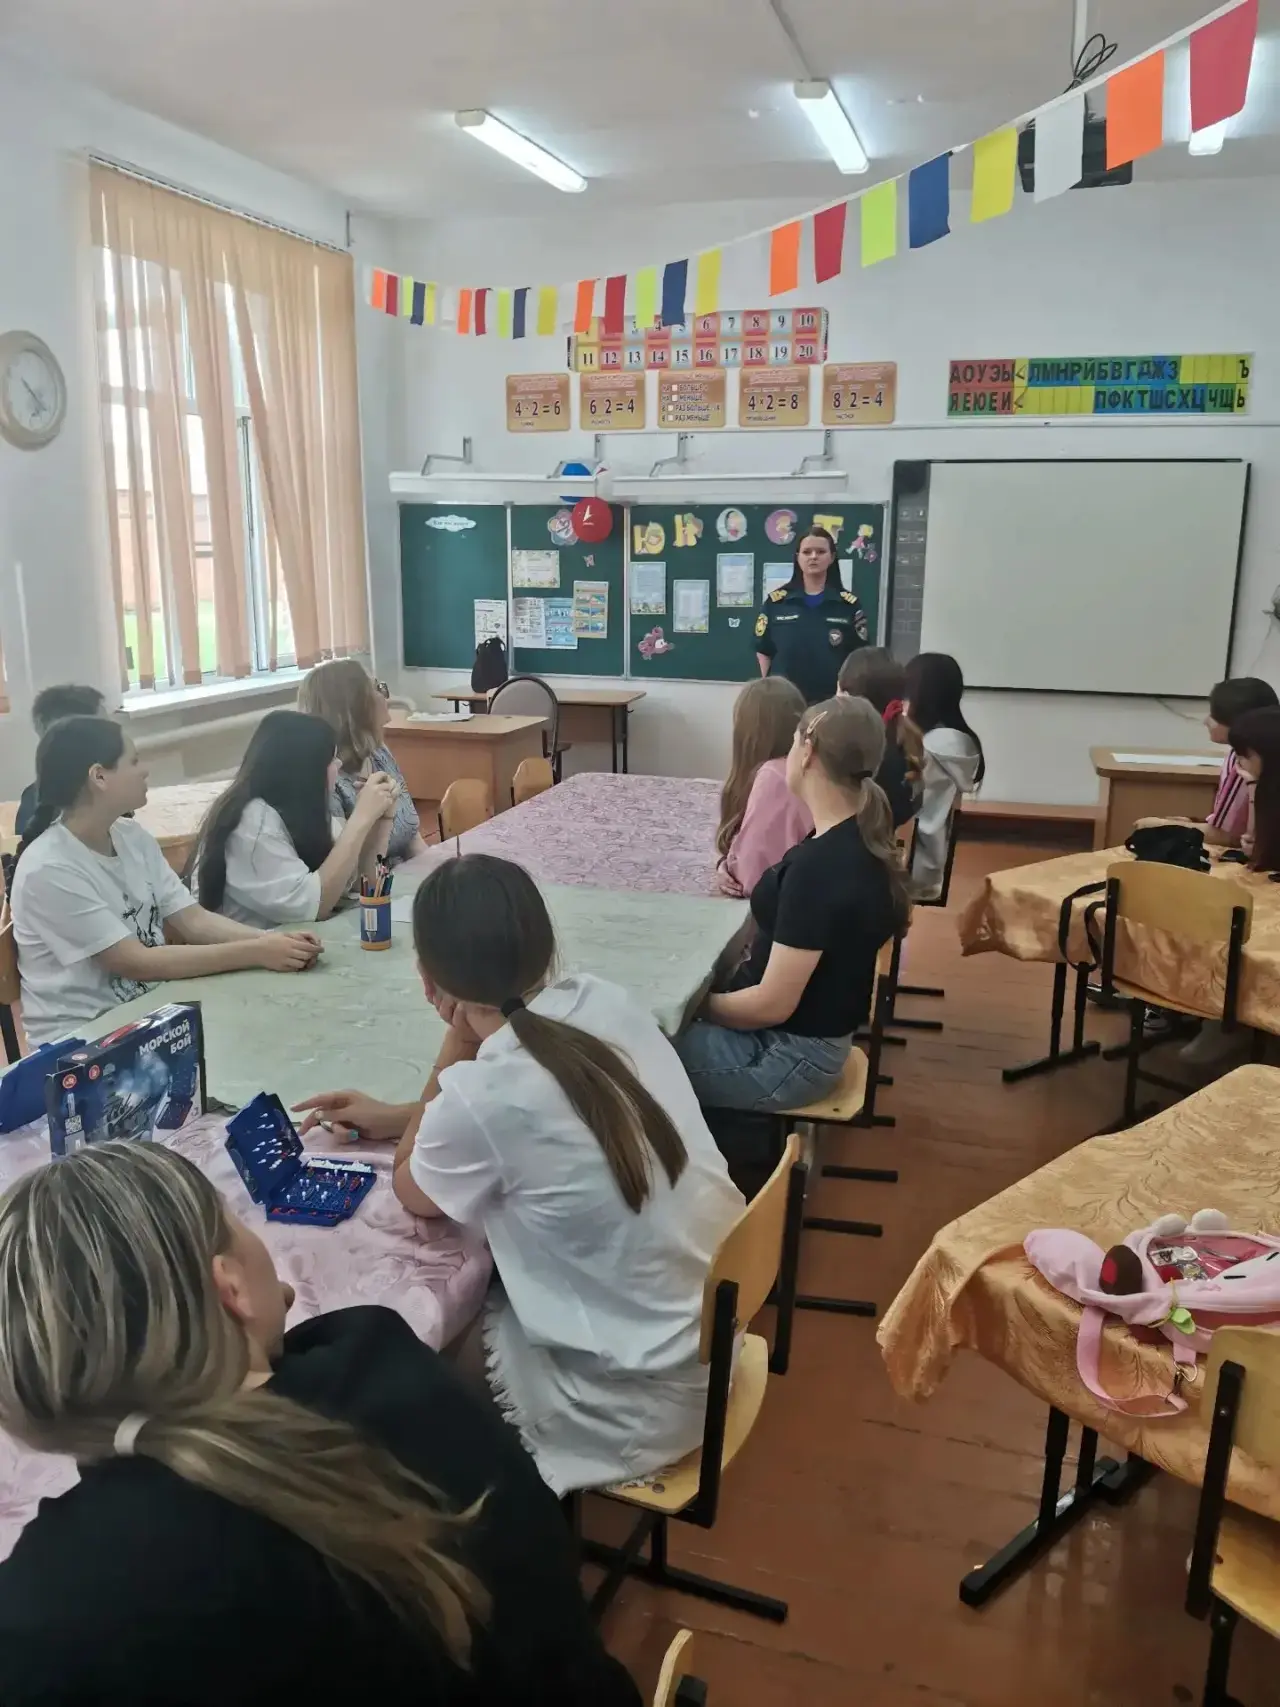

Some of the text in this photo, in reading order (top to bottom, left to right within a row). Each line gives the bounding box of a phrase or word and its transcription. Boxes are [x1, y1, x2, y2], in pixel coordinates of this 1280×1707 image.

[703, 318, 710, 330] 6
[728, 316, 735, 328] 7
[752, 315, 760, 328] 8
[778, 315, 785, 328] 9
[801, 313, 814, 326] 10
[583, 345, 813, 365] 11 12 13 14 15 16 17 18 19 20
[766, 394, 774, 410] 2
[790, 394, 798, 410] 8
[833, 392, 841, 408] 8
[849, 392, 857, 408] 2
[874, 391, 882, 407] 4
[139, 1018, 190, 1056] МОРСКОЙ
[170, 1033, 191, 1054] БОЙ
